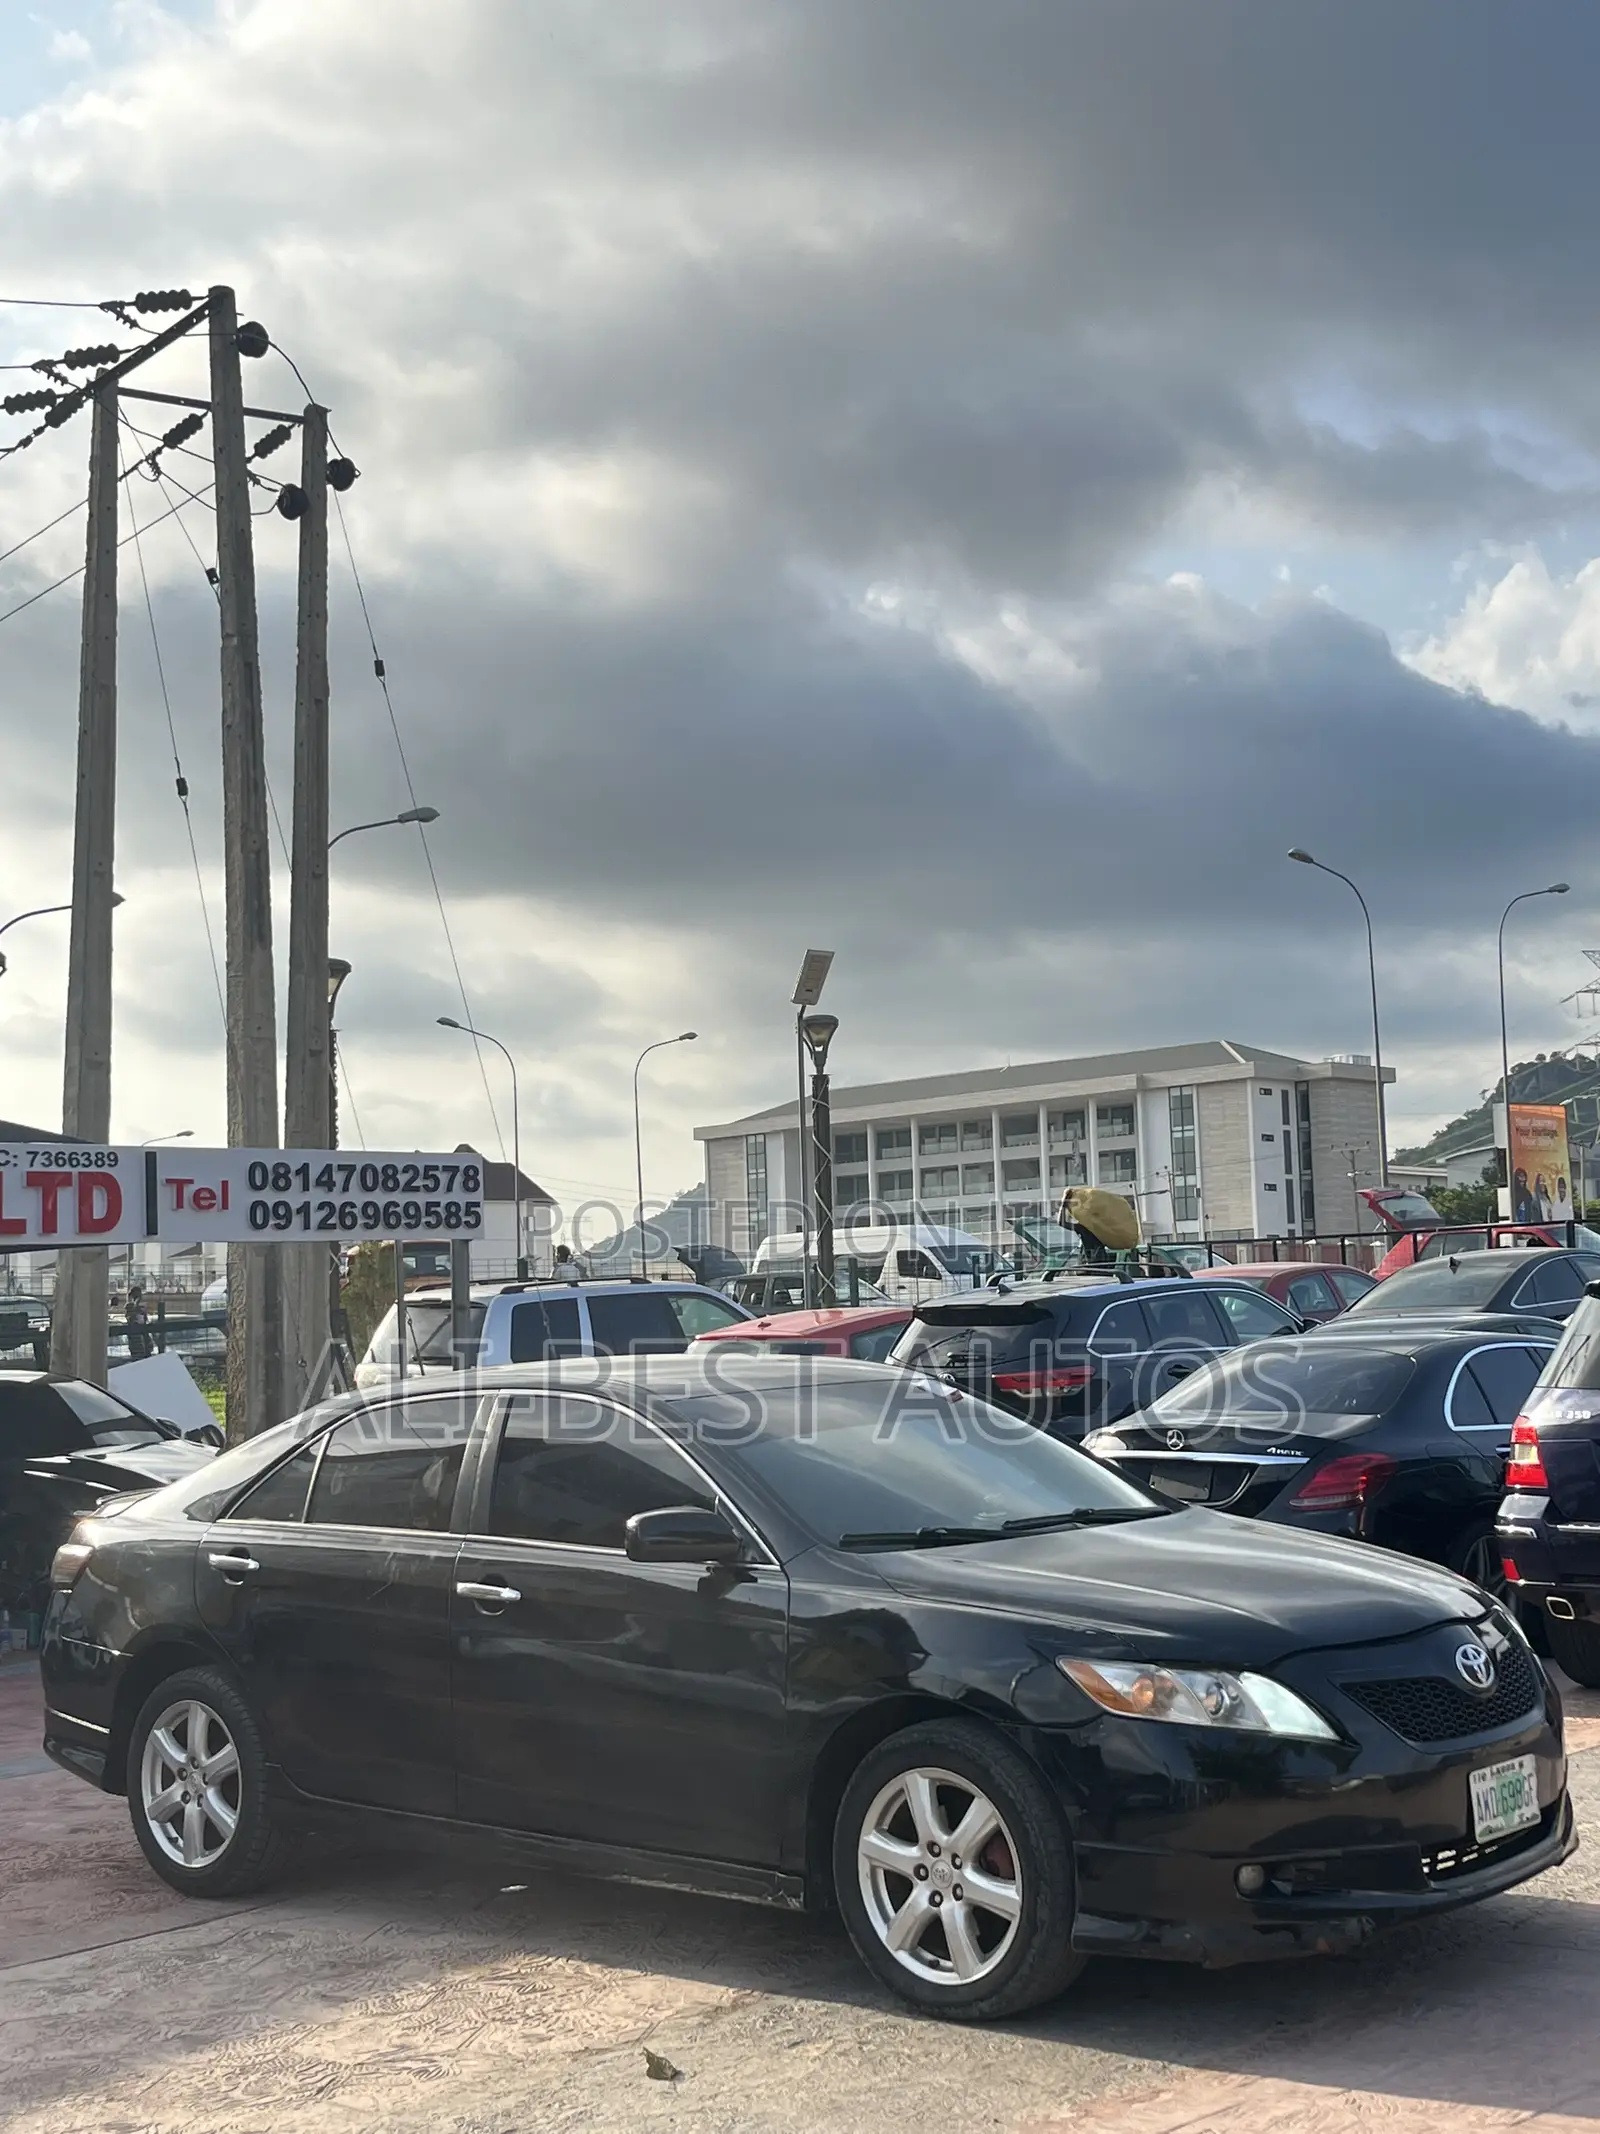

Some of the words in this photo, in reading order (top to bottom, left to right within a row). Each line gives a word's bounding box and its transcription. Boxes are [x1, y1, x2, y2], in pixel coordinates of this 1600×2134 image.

[26, 1151, 119, 1168] 7366389
[247, 1161, 481, 1193] 08147082578
[0, 1171, 123, 1235] LTD
[164, 1178, 229, 1210] Tel
[249, 1200, 482, 1230] 09126969585
